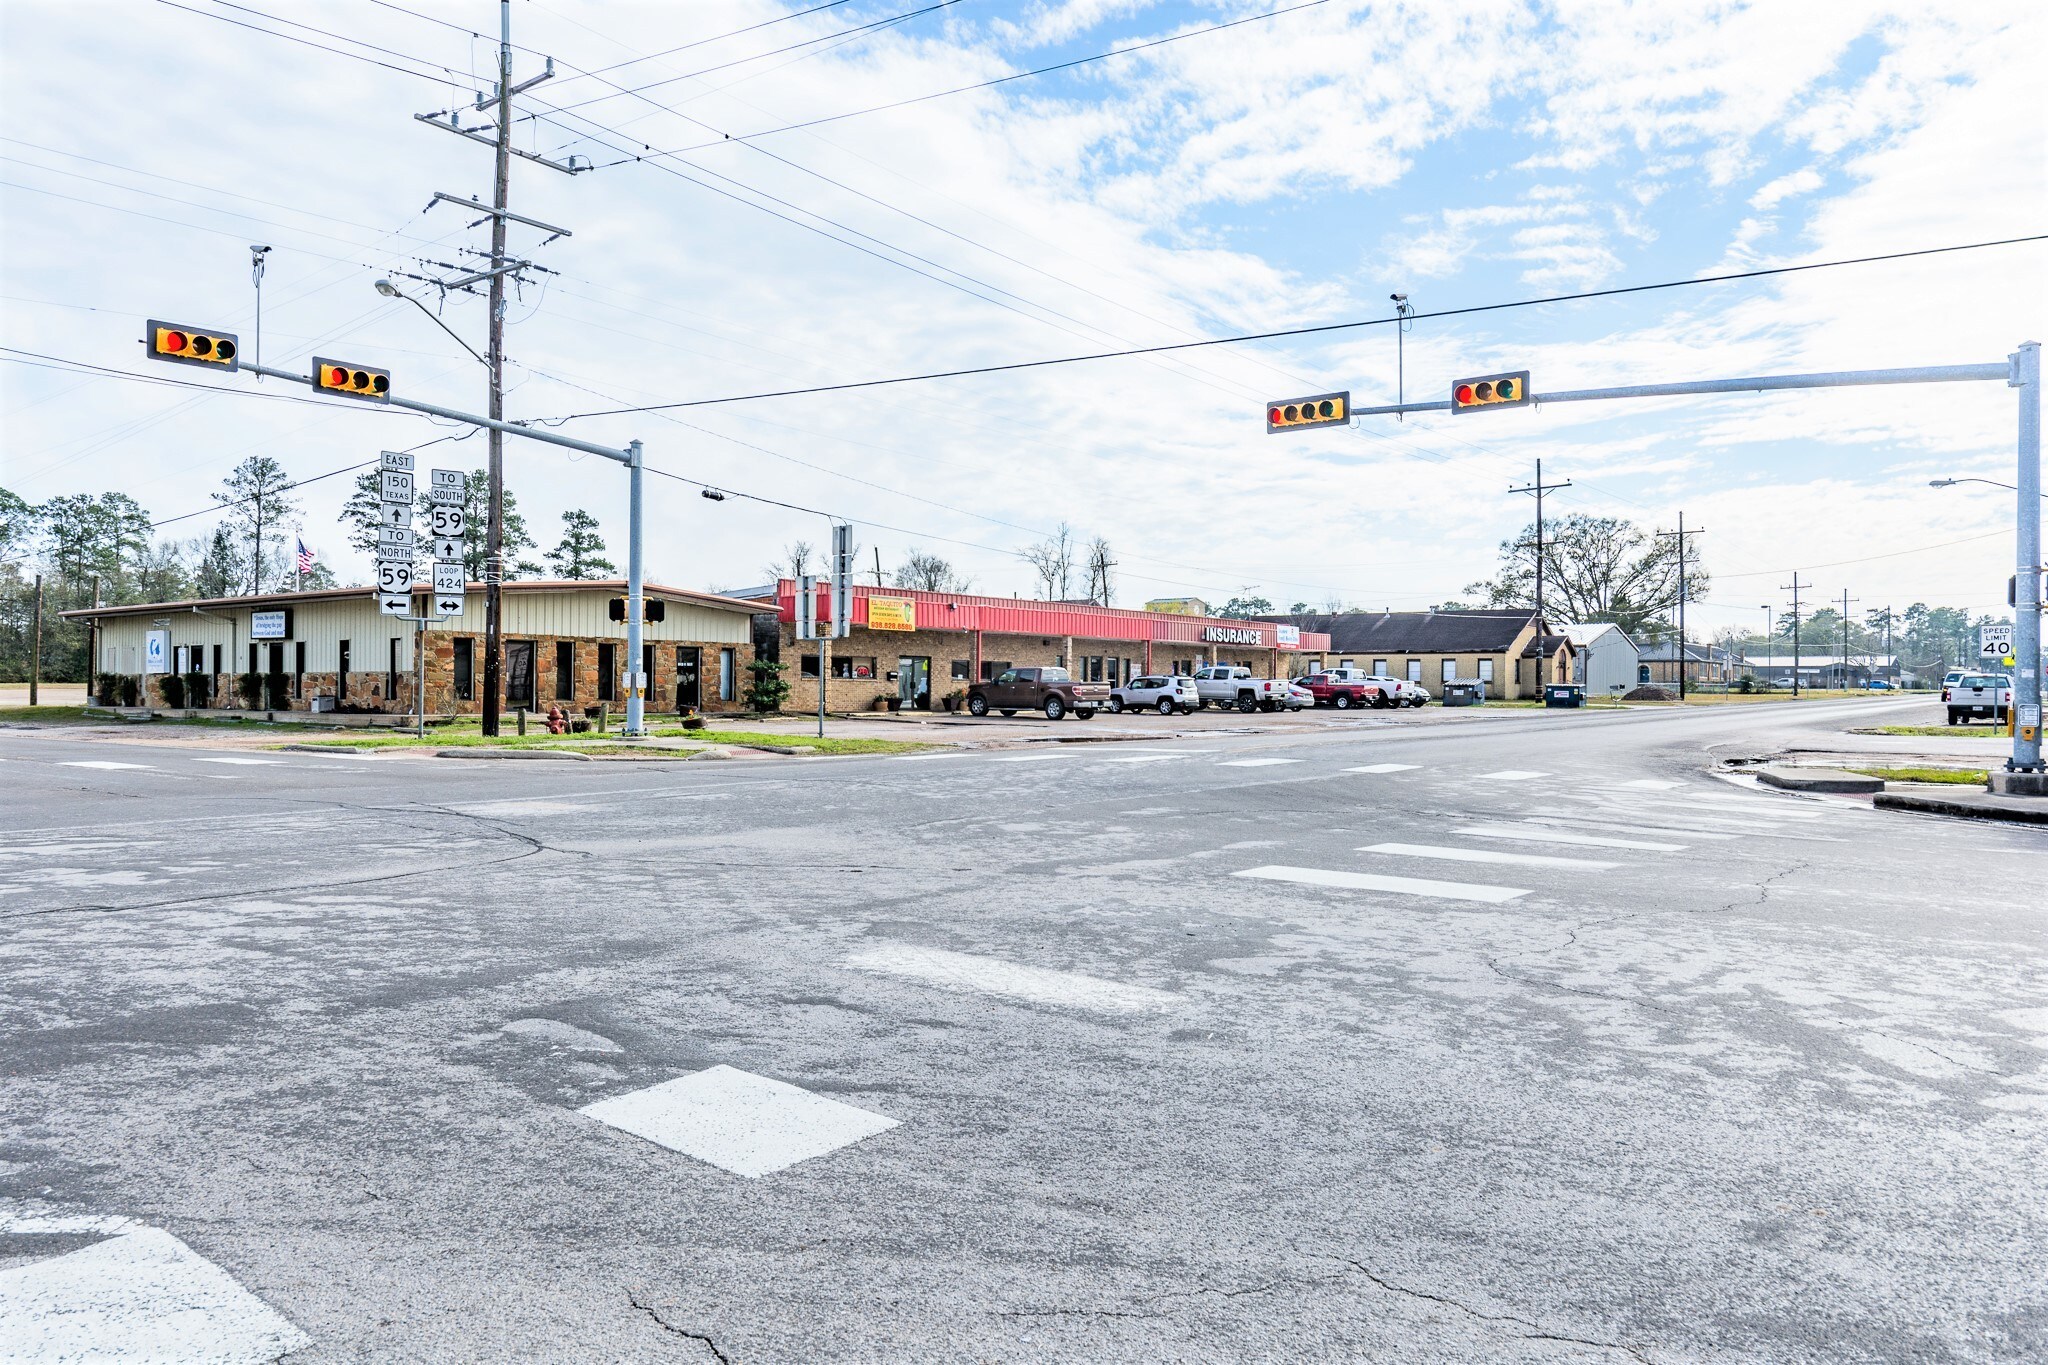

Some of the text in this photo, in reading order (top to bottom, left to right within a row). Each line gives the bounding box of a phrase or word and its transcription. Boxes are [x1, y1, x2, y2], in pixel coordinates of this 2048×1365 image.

[386, 455, 410, 467] EAST
[387, 476, 408, 488] 150
[440, 473, 456, 483] TO
[385, 491, 410, 500] TEXAS
[434, 490, 463, 502] SOUTH
[435, 512, 461, 530] 59
[388, 530, 404, 540] TO
[381, 547, 410, 559] NORTH
[439, 566, 459, 574] LOOP
[382, 568, 409, 586] 59
[437, 578, 462, 589] 424
[1206, 626, 1262, 645] INSURANCE
[1983, 642, 2010, 654] 40
